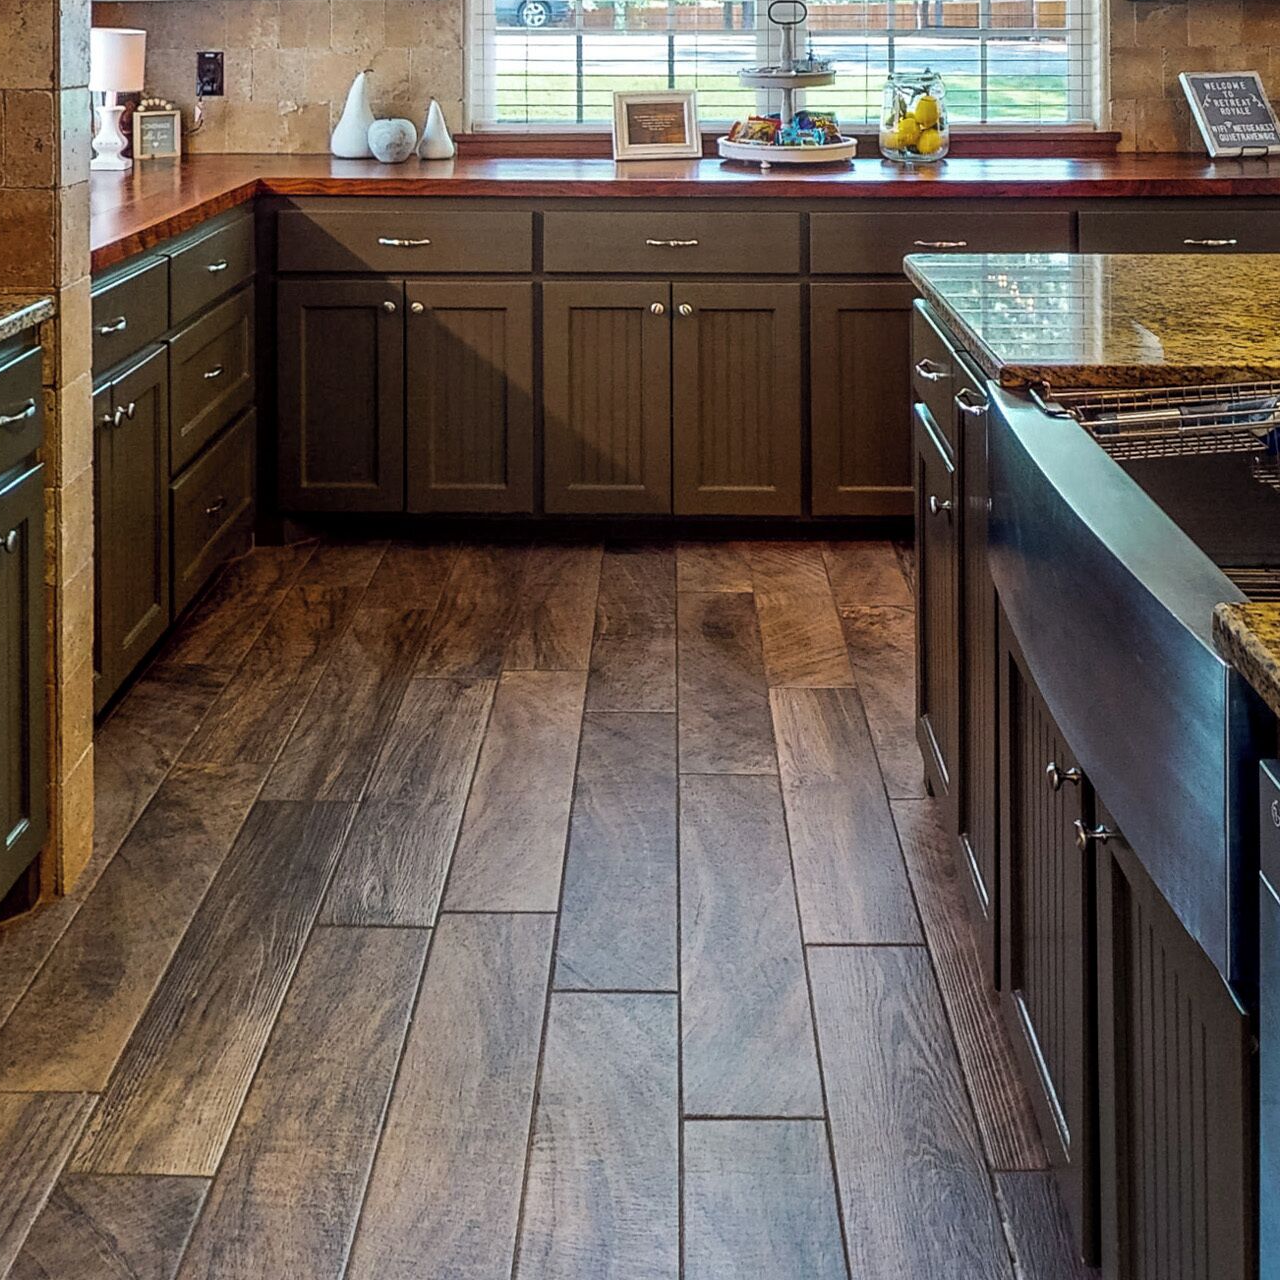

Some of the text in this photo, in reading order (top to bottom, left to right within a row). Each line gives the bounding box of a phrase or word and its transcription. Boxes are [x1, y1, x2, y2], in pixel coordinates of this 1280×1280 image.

[1203, 81, 1246, 90] WELCOME
[1222, 90, 1235, 98] TO
[1213, 98, 1251, 107] RETREAT
[1220, 107, 1252, 115] ROYALE
